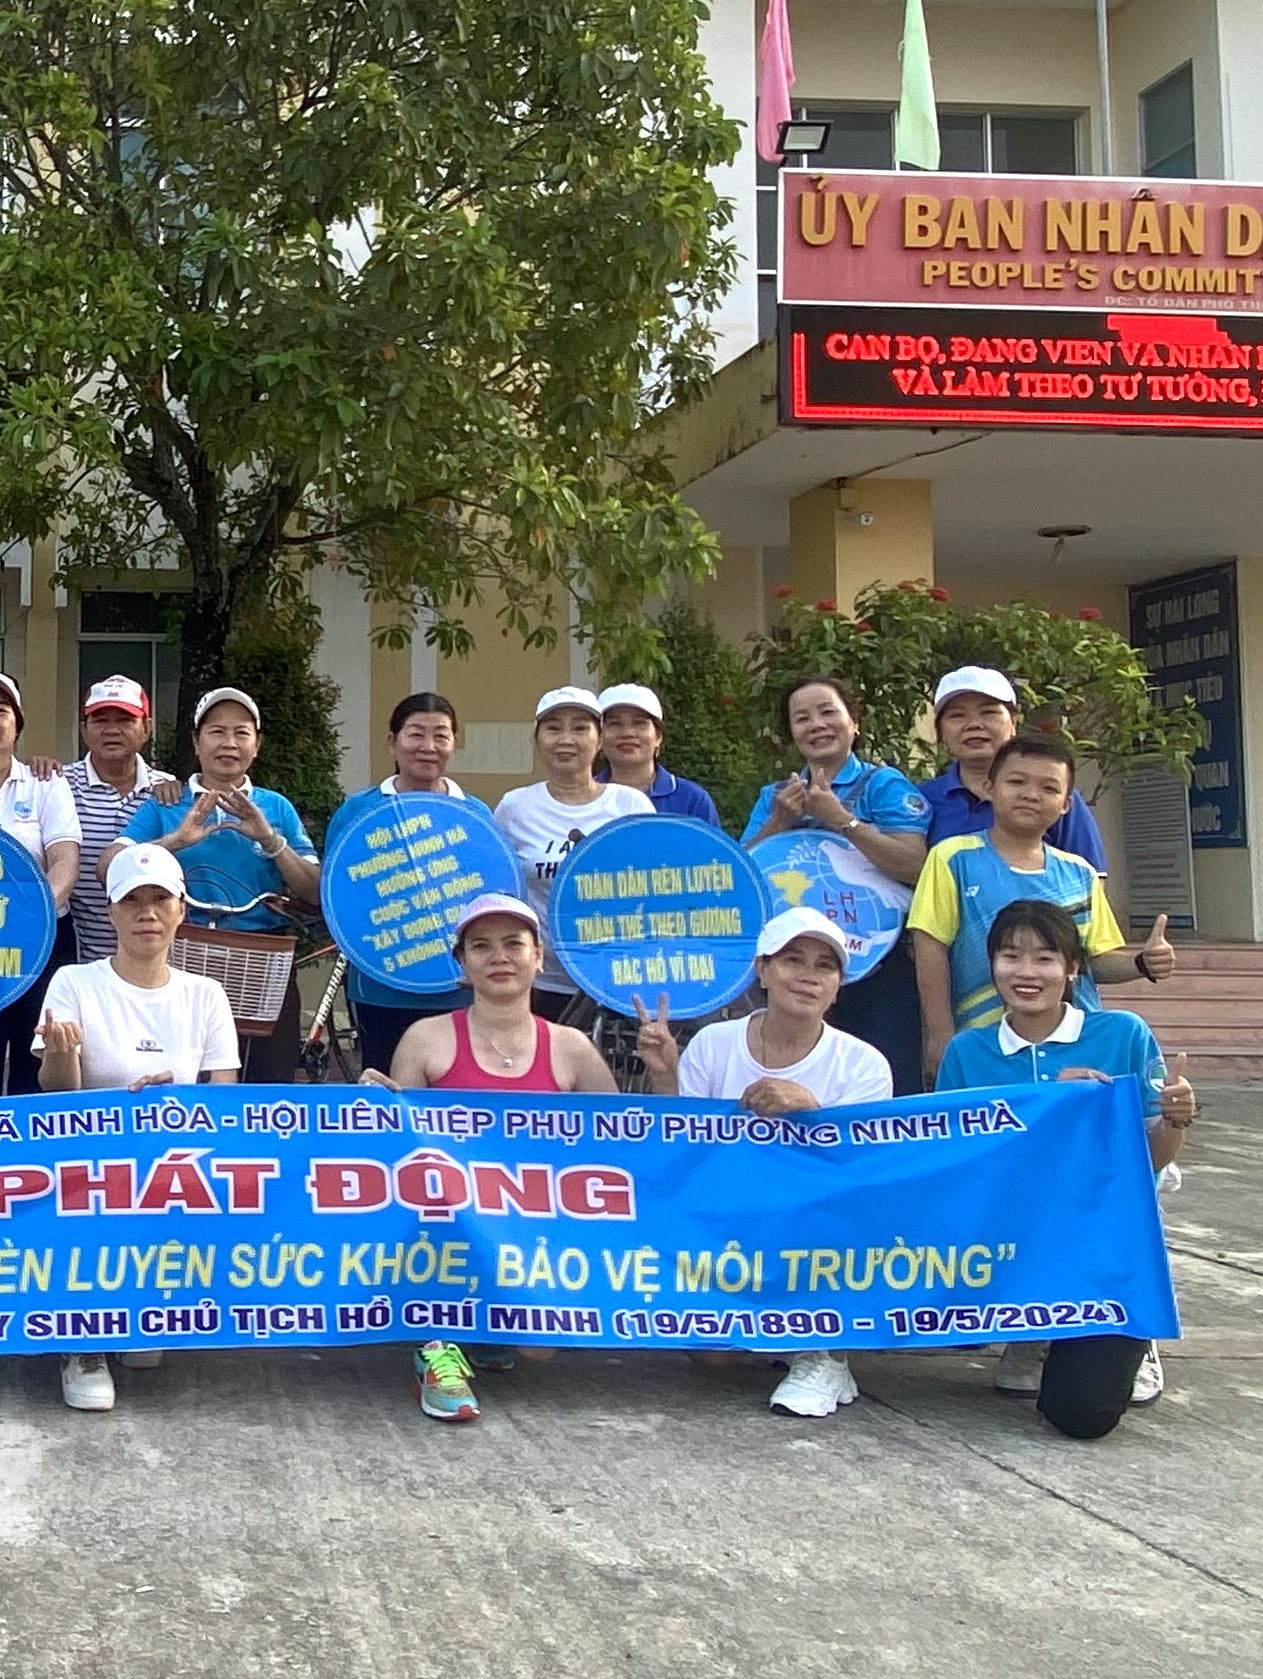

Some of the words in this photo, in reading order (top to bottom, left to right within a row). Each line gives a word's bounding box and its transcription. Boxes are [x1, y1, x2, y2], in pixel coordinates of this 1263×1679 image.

[904, 194, 1023, 250] BAN
[1045, 187, 1206, 255] NHÂN
[923, 259, 1100, 291] PEOPLE'S
[1014, 371, 1095, 399] THEO
[30, 1103, 123, 1140] NINH
[134, 1095, 215, 1134] HÒA
[244, 1099, 309, 1142] HỘI
[317, 1097, 403, 1133] LIÊN
[412, 1104, 494, 1143] HIỆP
[504, 1108, 586, 1146] PHỤ
[593, 1110, 654, 1142] NỮ
[851, 1110, 950, 1146] NINH
[959, 1099, 1028, 1140] HÀ
[305, 1146, 637, 1223] ĐỘNG
[65, 1239, 217, 1300] LUYỆN
[227, 1231, 326, 1288] SỨC
[494, 1236, 589, 1290] BẢO
[602, 1245, 661, 1303] VỆ
[674, 1239, 763, 1294] MÔI
[22, 1307, 130, 1340] SINH
[138, 1299, 221, 1337] CHỦ
[231, 1302, 327, 1339] TỊCH
[337, 1294, 393, 1333] HỒ
[402, 1296, 482, 1331] CHÍ
[488, 1303, 611, 1338] MINH
[612, 1306, 843, 1340] (19/5/1890
[884, 1300, 1128, 1336] 19/5/2024)
